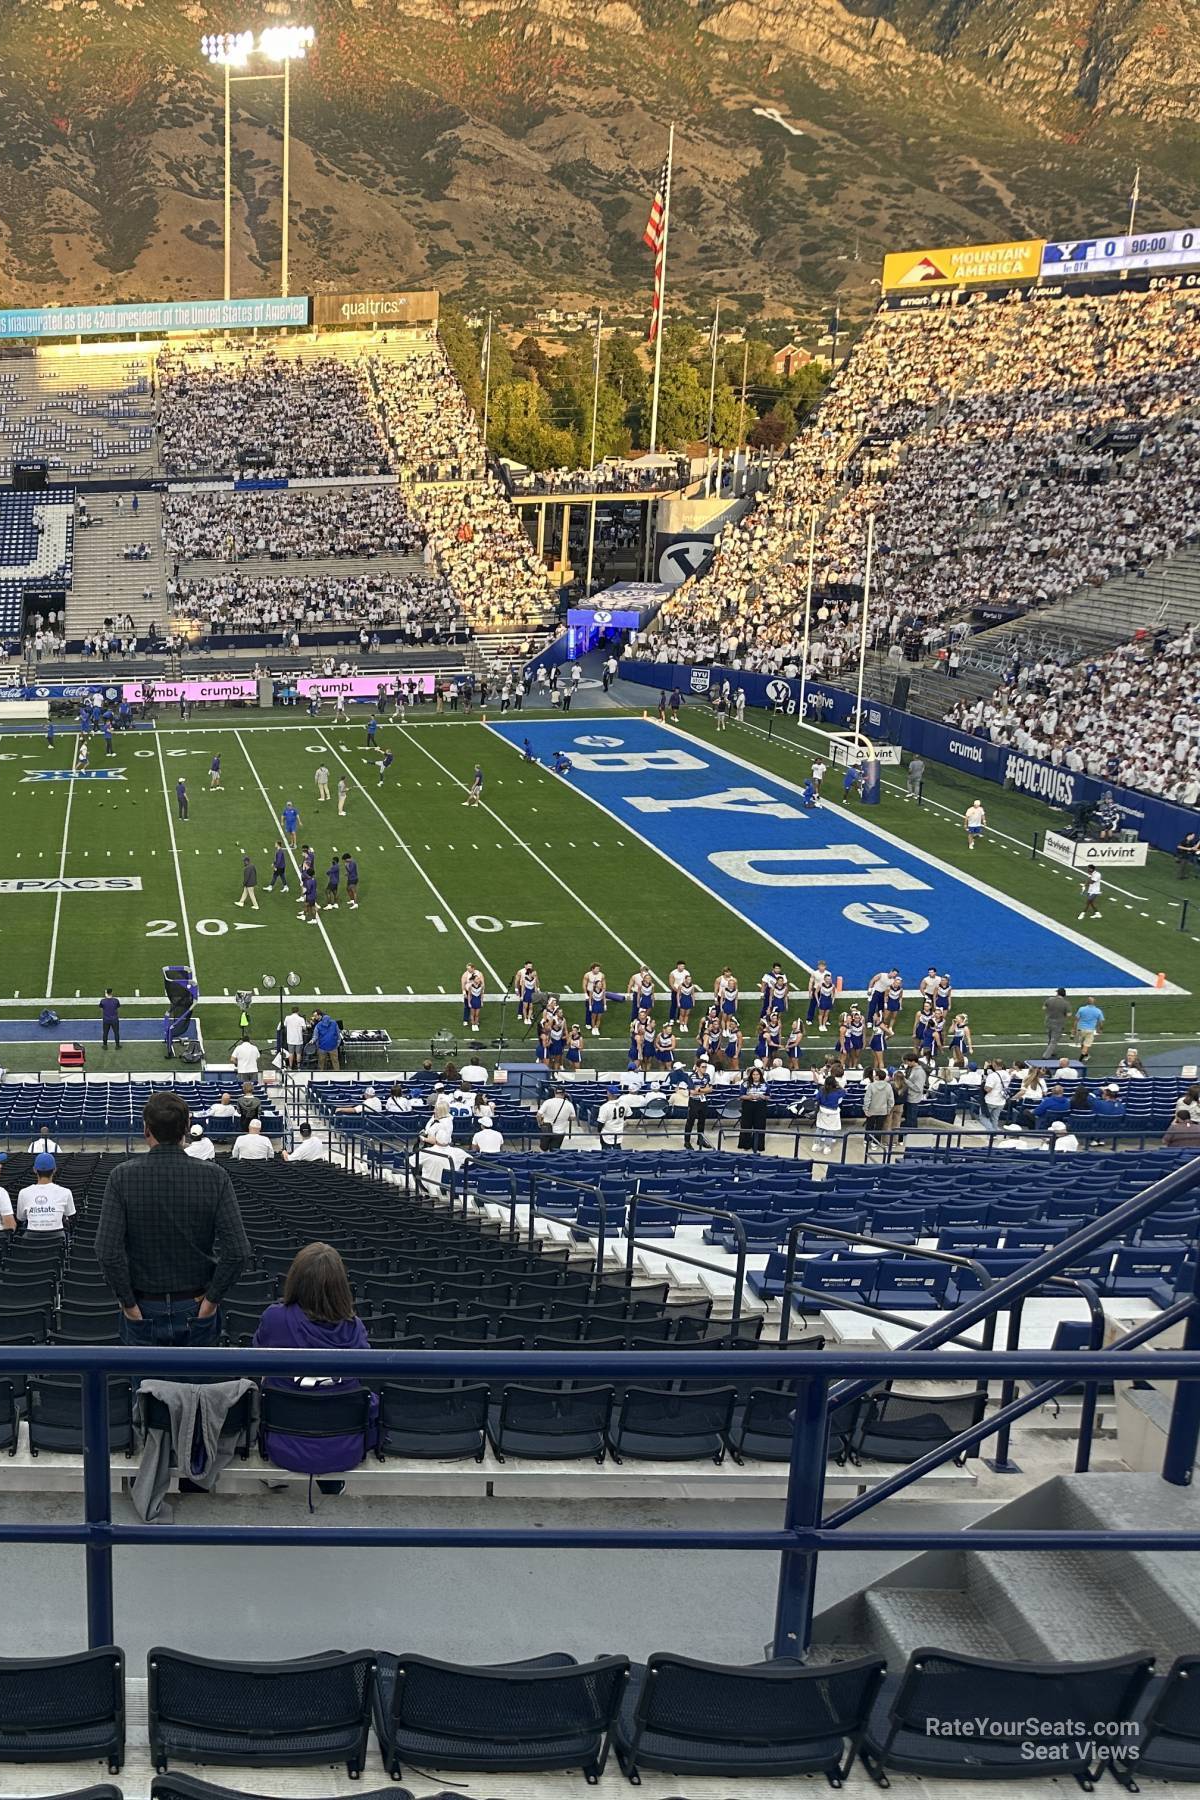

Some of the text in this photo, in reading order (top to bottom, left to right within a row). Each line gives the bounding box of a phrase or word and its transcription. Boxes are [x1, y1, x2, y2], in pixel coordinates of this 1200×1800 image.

[1104, 241, 1116, 257] 0
[1182, 233, 1194, 249] 0
[951, 246, 1031, 265] MOUNTAIN
[954, 261, 1025, 278] AMERICA
[8, 314, 62, 335] inaugurated
[64, 317, 75, 330] as
[77, 312, 92, 328] the
[94, 311, 115, 328] 42nd
[117, 308, 162, 329] president
[163, 308, 173, 325] of
[175, 307, 190, 324] the
[191, 305, 220, 324] United
[222, 304, 253, 322] States
[254, 303, 264, 321] of
[265, 301, 305, 321] America
[692, 669, 708, 678] BYU
[201, 683, 244, 696] crumbl
[949, 740, 984, 763] crumbl
[1005, 754, 1075, 806] #GOCOUGS
[561, 749, 935, 891] BYU
[1097, 847, 1136, 858] vivint
[16, 879, 133, 891] PACS
[145, 919, 228, 937] 20
[425, 915, 504, 933] 10
[613, 1106, 625, 1120] 18
[28, 1206, 56, 1214] Allstate
